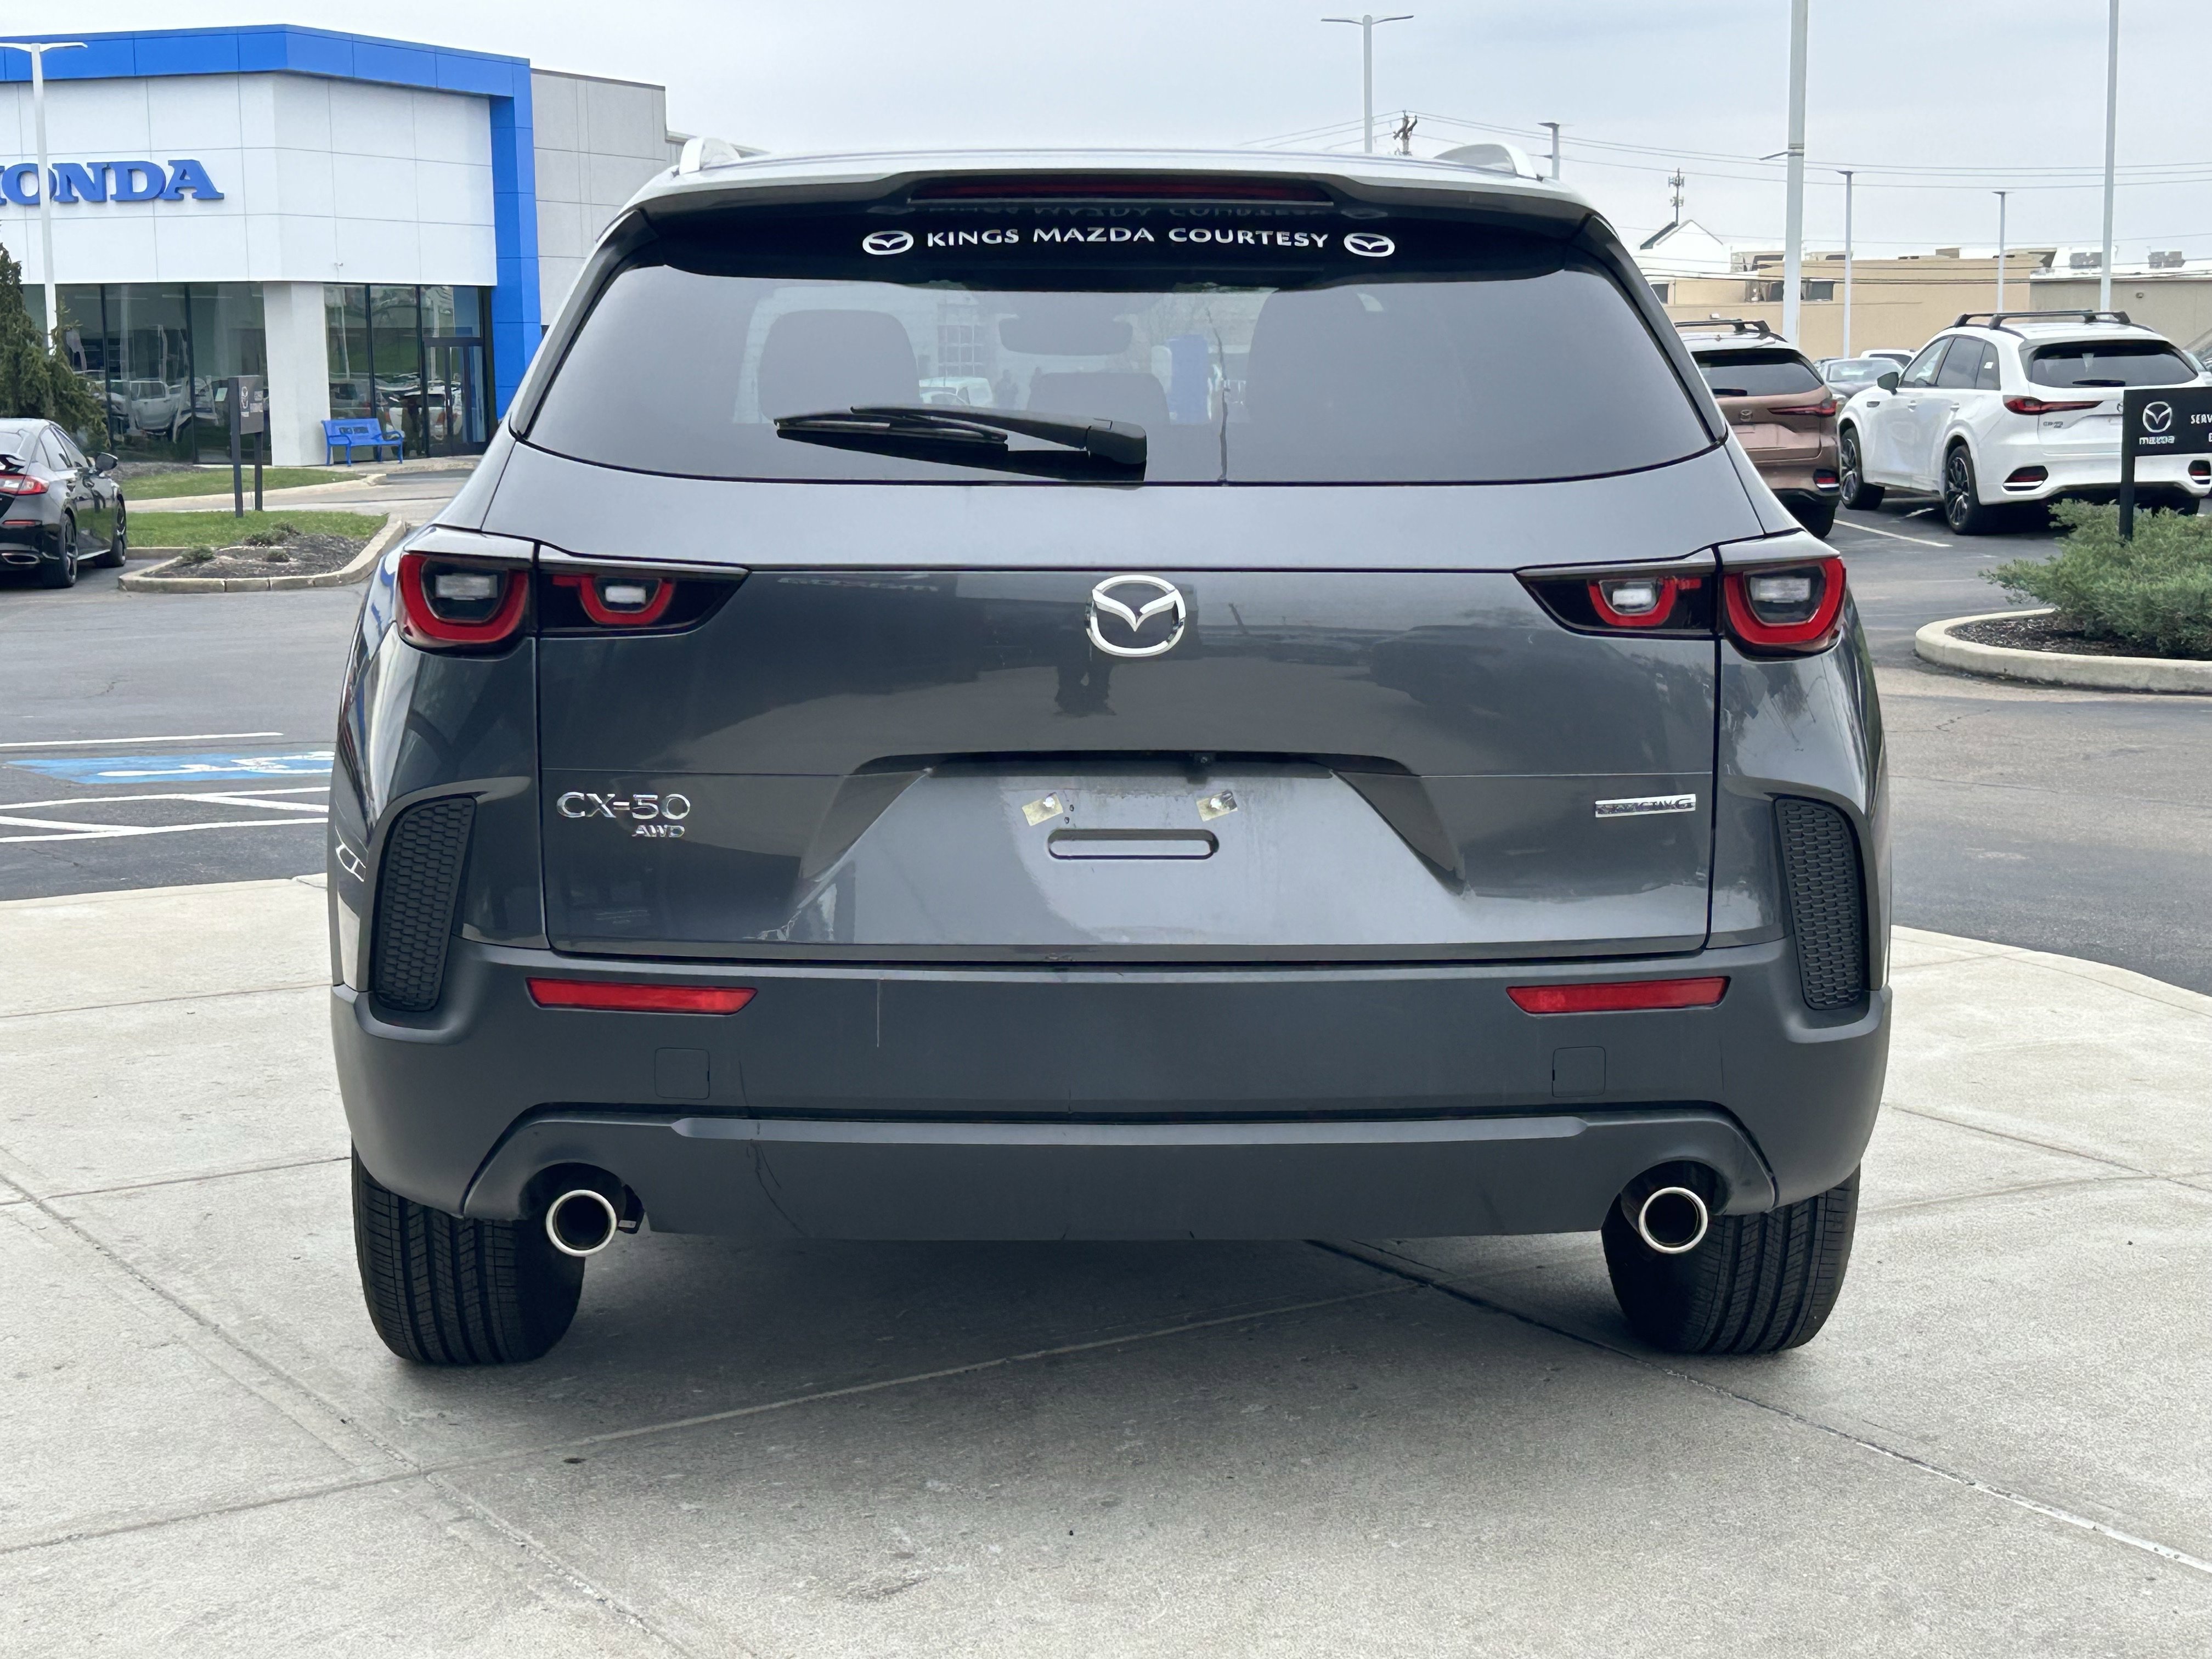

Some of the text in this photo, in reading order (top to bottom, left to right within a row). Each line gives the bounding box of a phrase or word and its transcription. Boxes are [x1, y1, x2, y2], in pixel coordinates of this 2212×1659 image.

[0, 160, 224, 205] ONDA
[927, 227, 1328, 248] KINGS MAZDA COURTESY
[556, 792, 691, 820] CX-50
[632, 825, 685, 838] AWD
